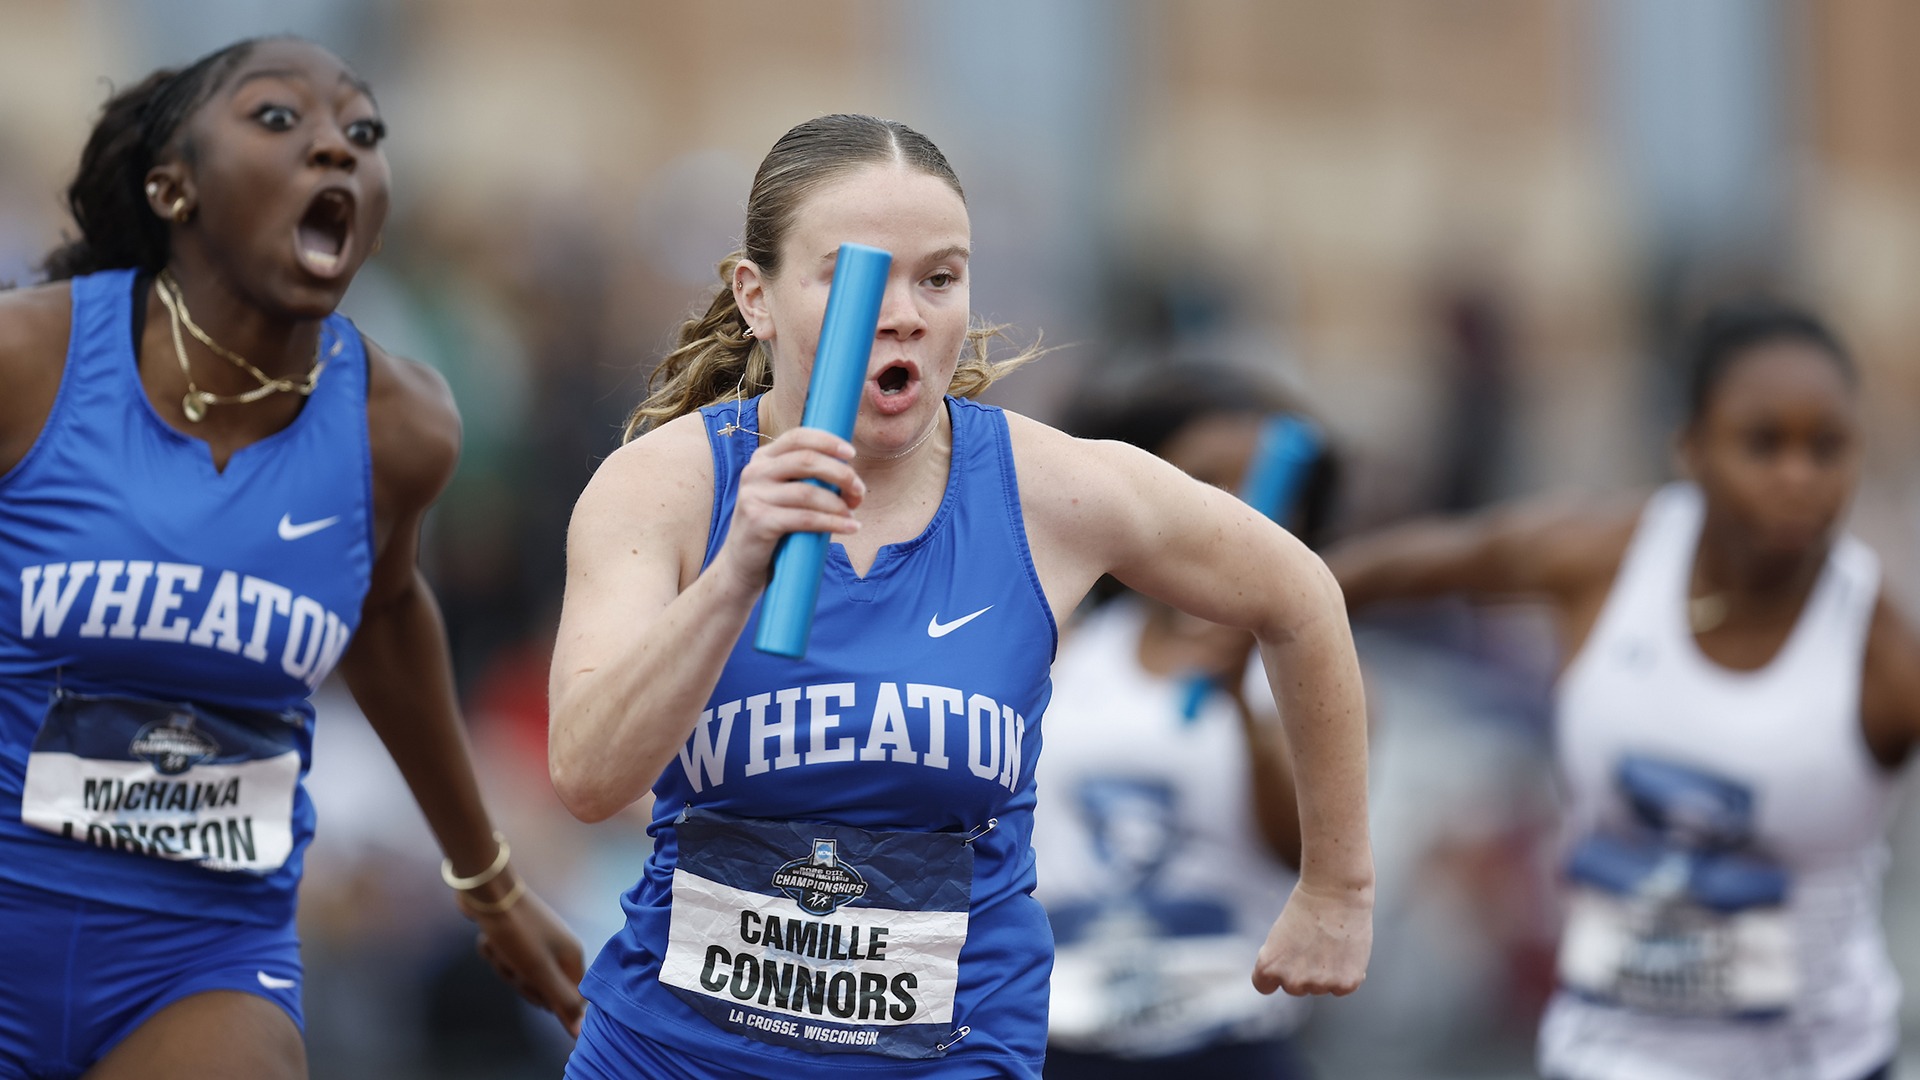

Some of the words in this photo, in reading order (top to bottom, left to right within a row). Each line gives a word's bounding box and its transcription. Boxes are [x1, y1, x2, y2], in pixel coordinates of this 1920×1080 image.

[20, 560, 350, 690] WHEATON
[679, 682, 1025, 794] WHEATON
[84, 777, 240, 812] MICHAINA
[775, 874, 864, 894] CHAMPIONSHIPS
[740, 910, 889, 961] CAMILLE
[699, 944, 918, 1021] CONNORS
[728, 1008, 743, 1024] LA
[746, 1013, 800, 1038] CROSSE,
[803, 1025, 879, 1046] WISCONSIN
